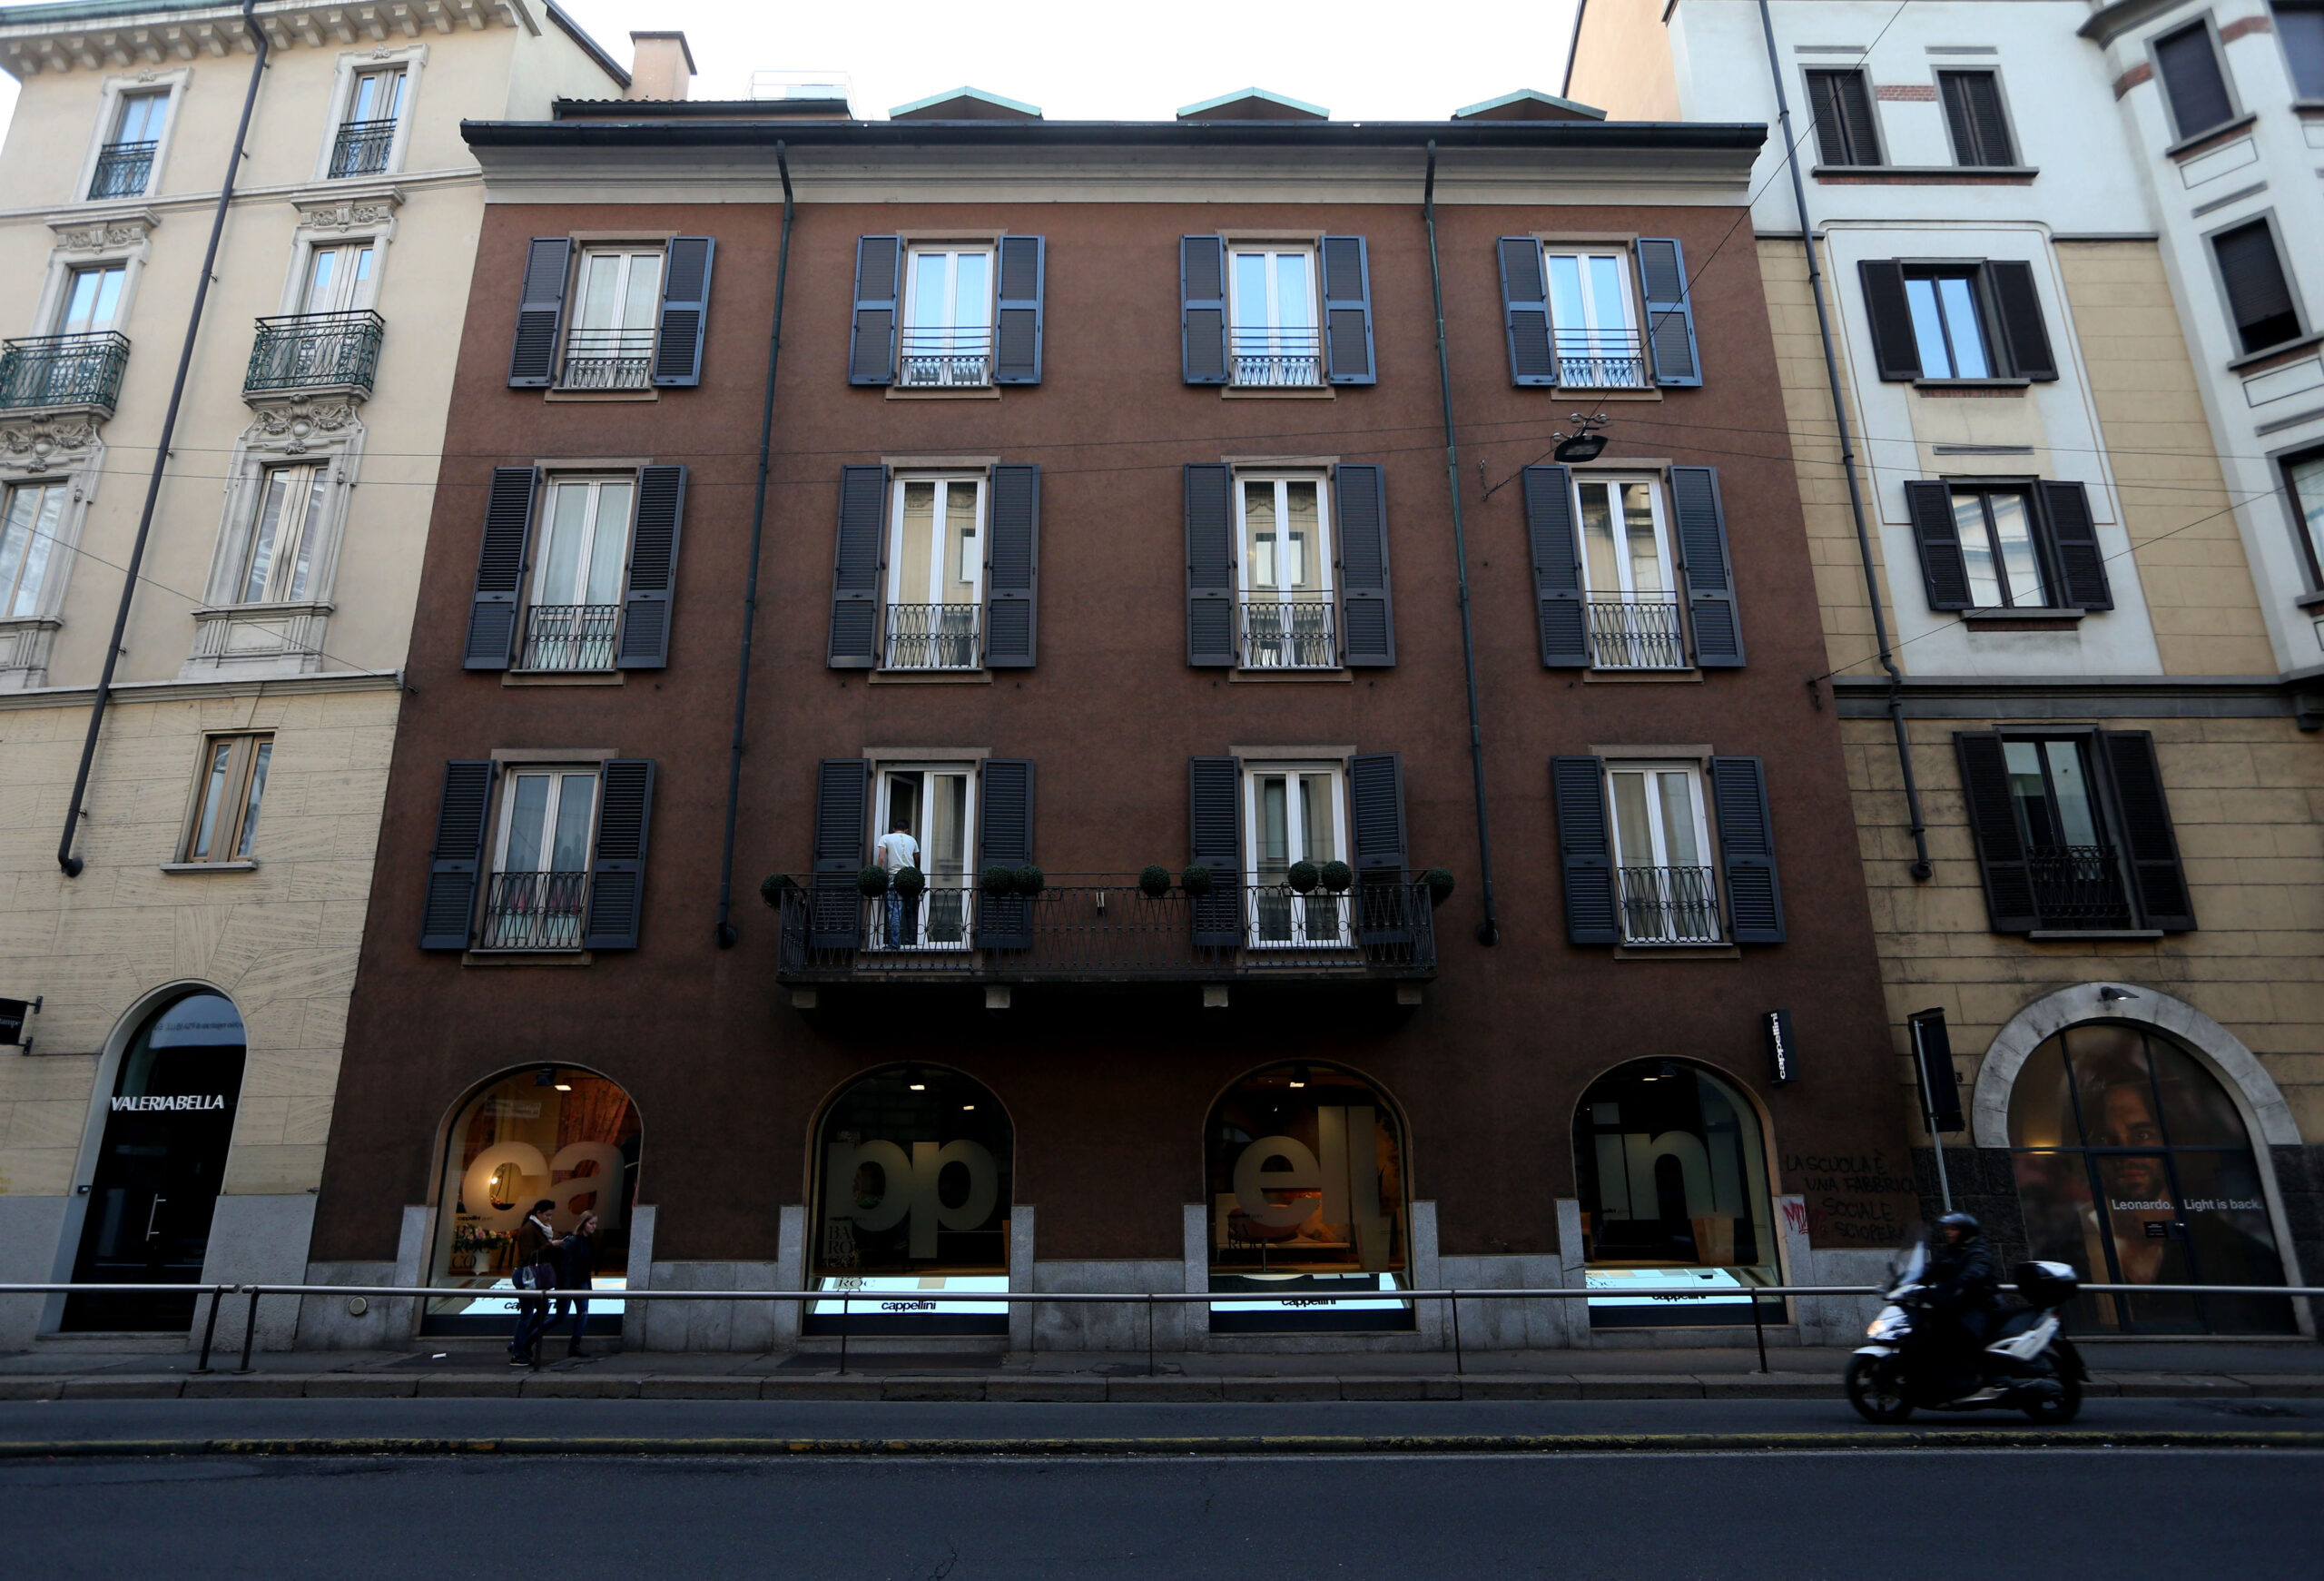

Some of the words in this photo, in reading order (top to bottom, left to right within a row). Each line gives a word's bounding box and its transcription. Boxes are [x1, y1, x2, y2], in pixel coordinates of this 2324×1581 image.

[1770, 1013, 1786, 1080] cappellini
[112, 1094, 225, 1112] VALERIABELLA
[1786, 1154, 1804, 1171] LA
[1807, 1156, 1870, 1172] SCUOLA
[1805, 1177, 1839, 1192] UNA
[1844, 1176, 1917, 1194] FABBRICA
[1822, 1197, 1895, 1221] SOCIALE
[2112, 1199, 2174, 1210] Leonardo.
[2183, 1199, 2215, 1211] Light
[2217, 1199, 2227, 1210] is
[2230, 1199, 2262, 1210] back.
[881, 1300, 937, 1312] cappellini
